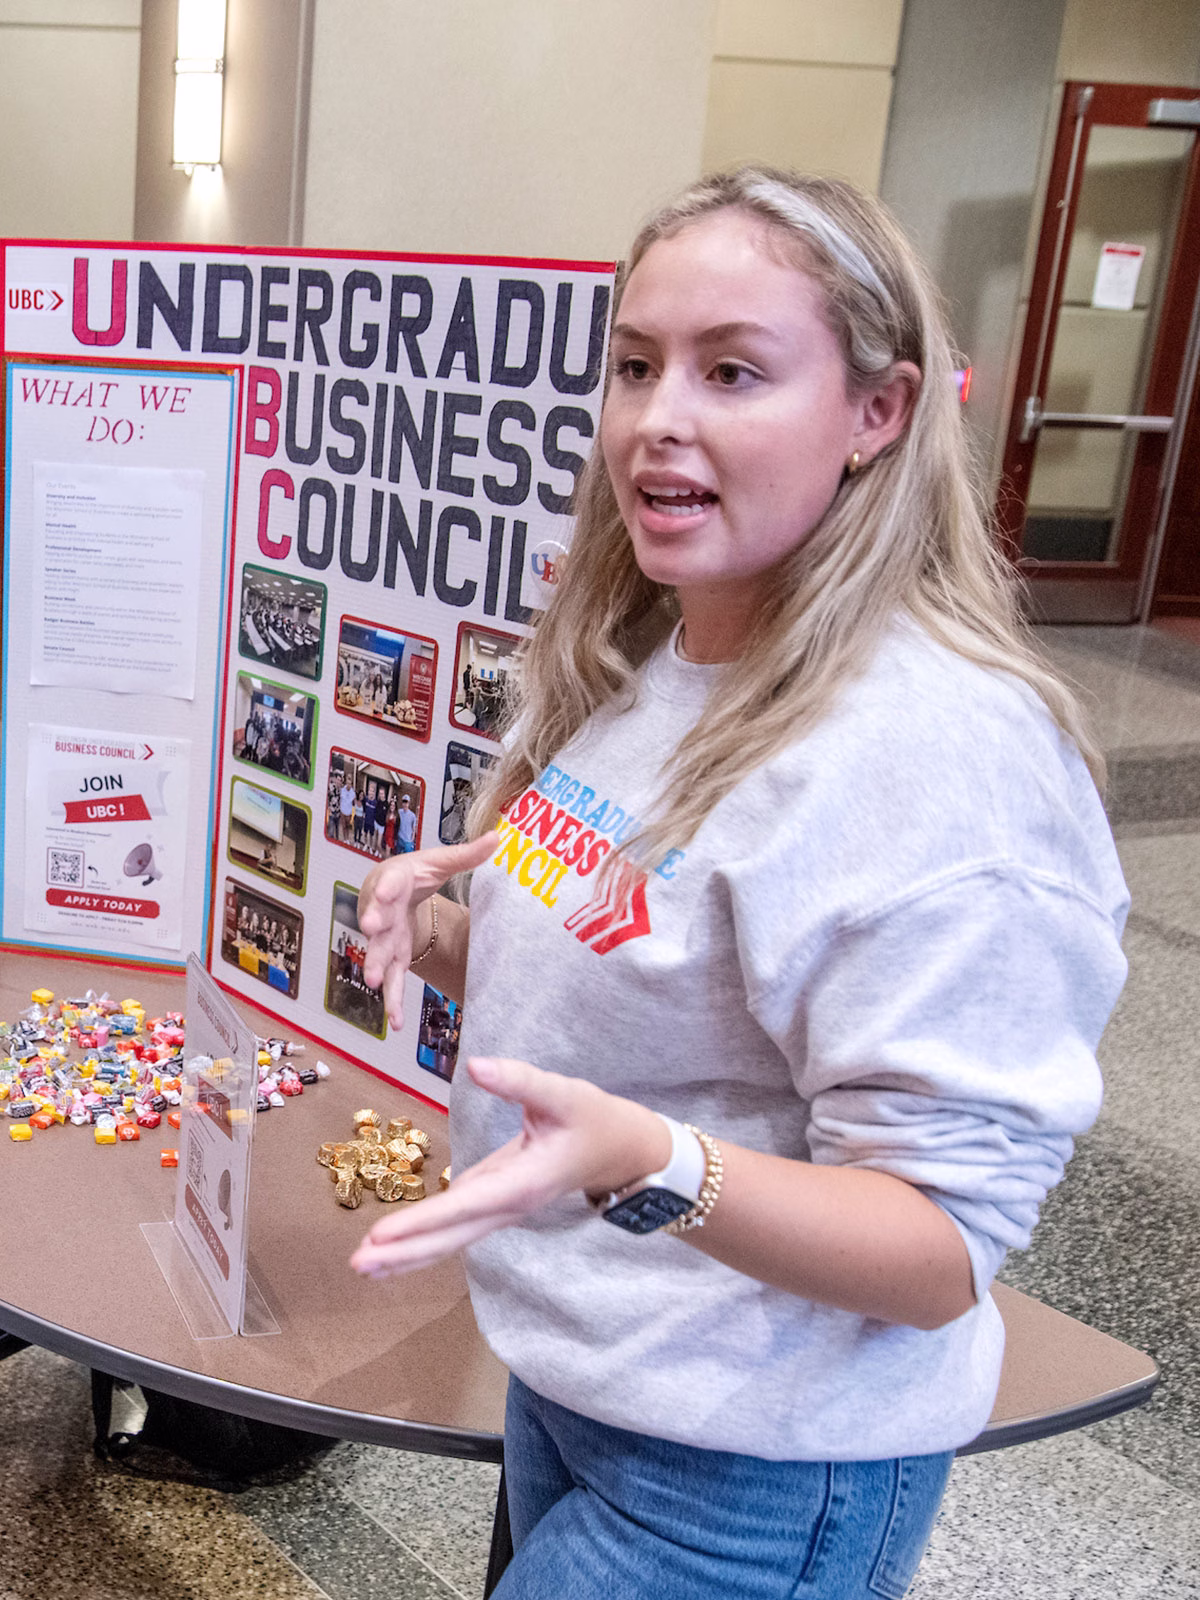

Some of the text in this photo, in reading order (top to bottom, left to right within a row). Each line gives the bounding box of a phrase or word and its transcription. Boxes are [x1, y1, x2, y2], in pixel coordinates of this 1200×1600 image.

[8, 289, 44, 310] UBC
[71, 257, 610, 395] UNDERGRADU
[21, 378, 192, 413] WHAT WE
[86, 415, 144, 445] DO:
[243, 364, 595, 516] BUSINESS
[257, 468, 536, 626] COUNCIL
[55, 741, 136, 760] BUSINESS COUNCIL
[80, 774, 123, 792] JOIN
[64, 894, 143, 914] APPLY TODAY
